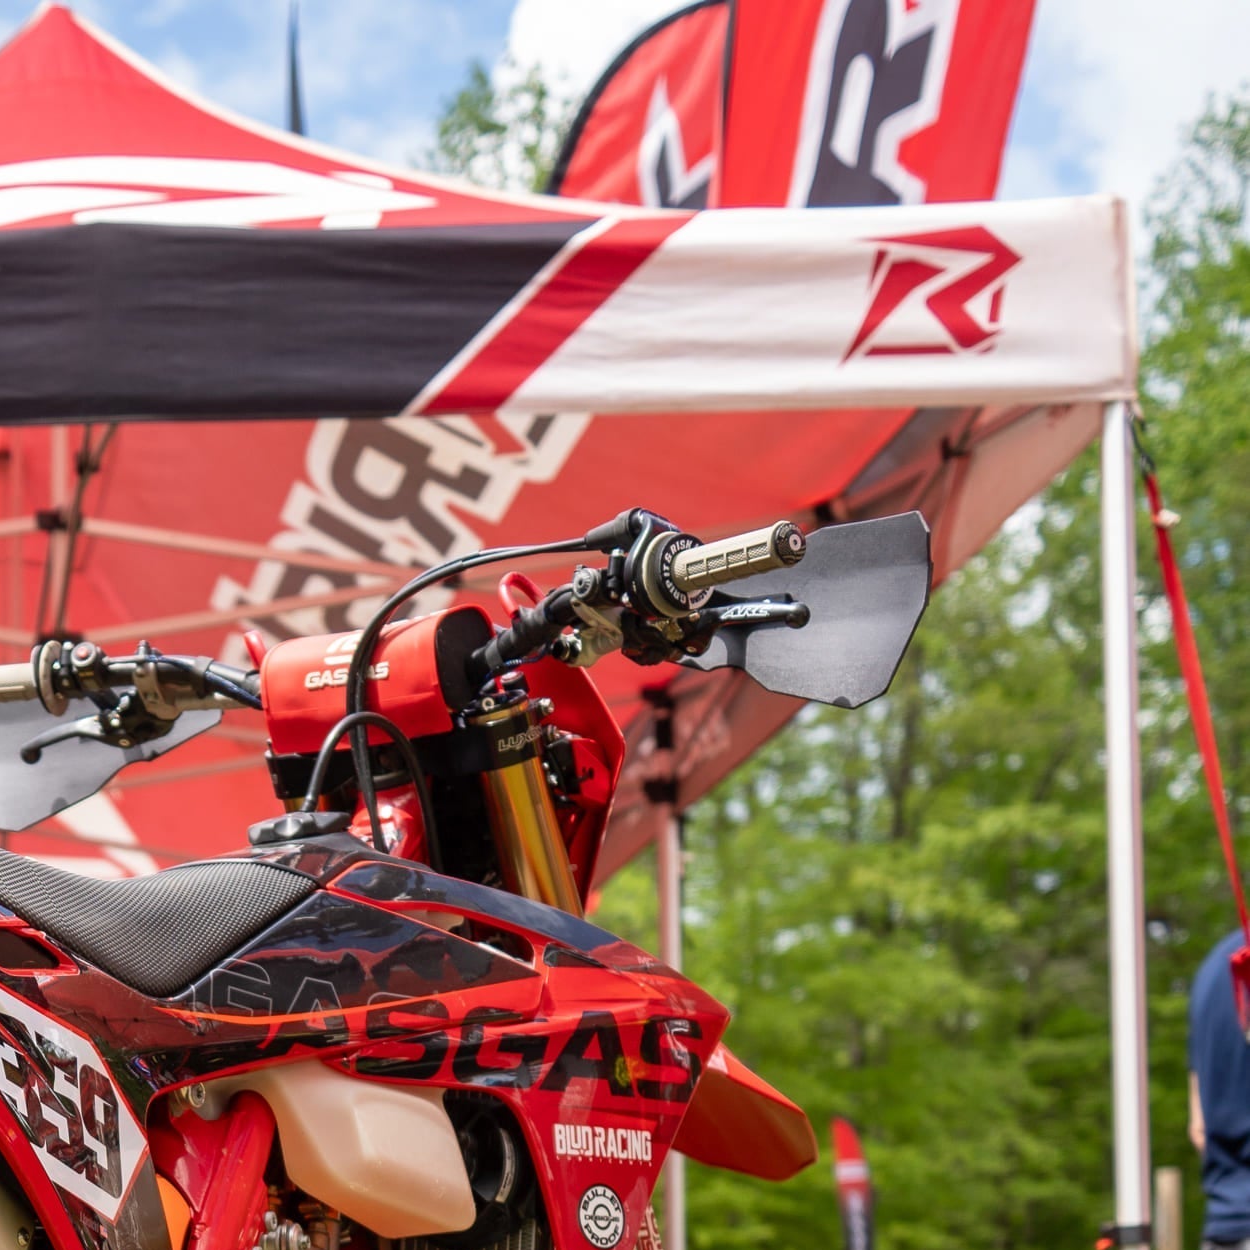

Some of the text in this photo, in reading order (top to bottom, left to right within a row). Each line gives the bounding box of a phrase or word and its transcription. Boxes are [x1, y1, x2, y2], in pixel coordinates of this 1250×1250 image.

[670, 539, 693, 555] RISK
[304, 660, 390, 691] GASAS
[190, 957, 706, 1101] GASGAS
[594, 1126, 653, 1162] RACING
[582, 1188, 622, 1213] BULLET
[584, 1223, 620, 1246] PROOF
